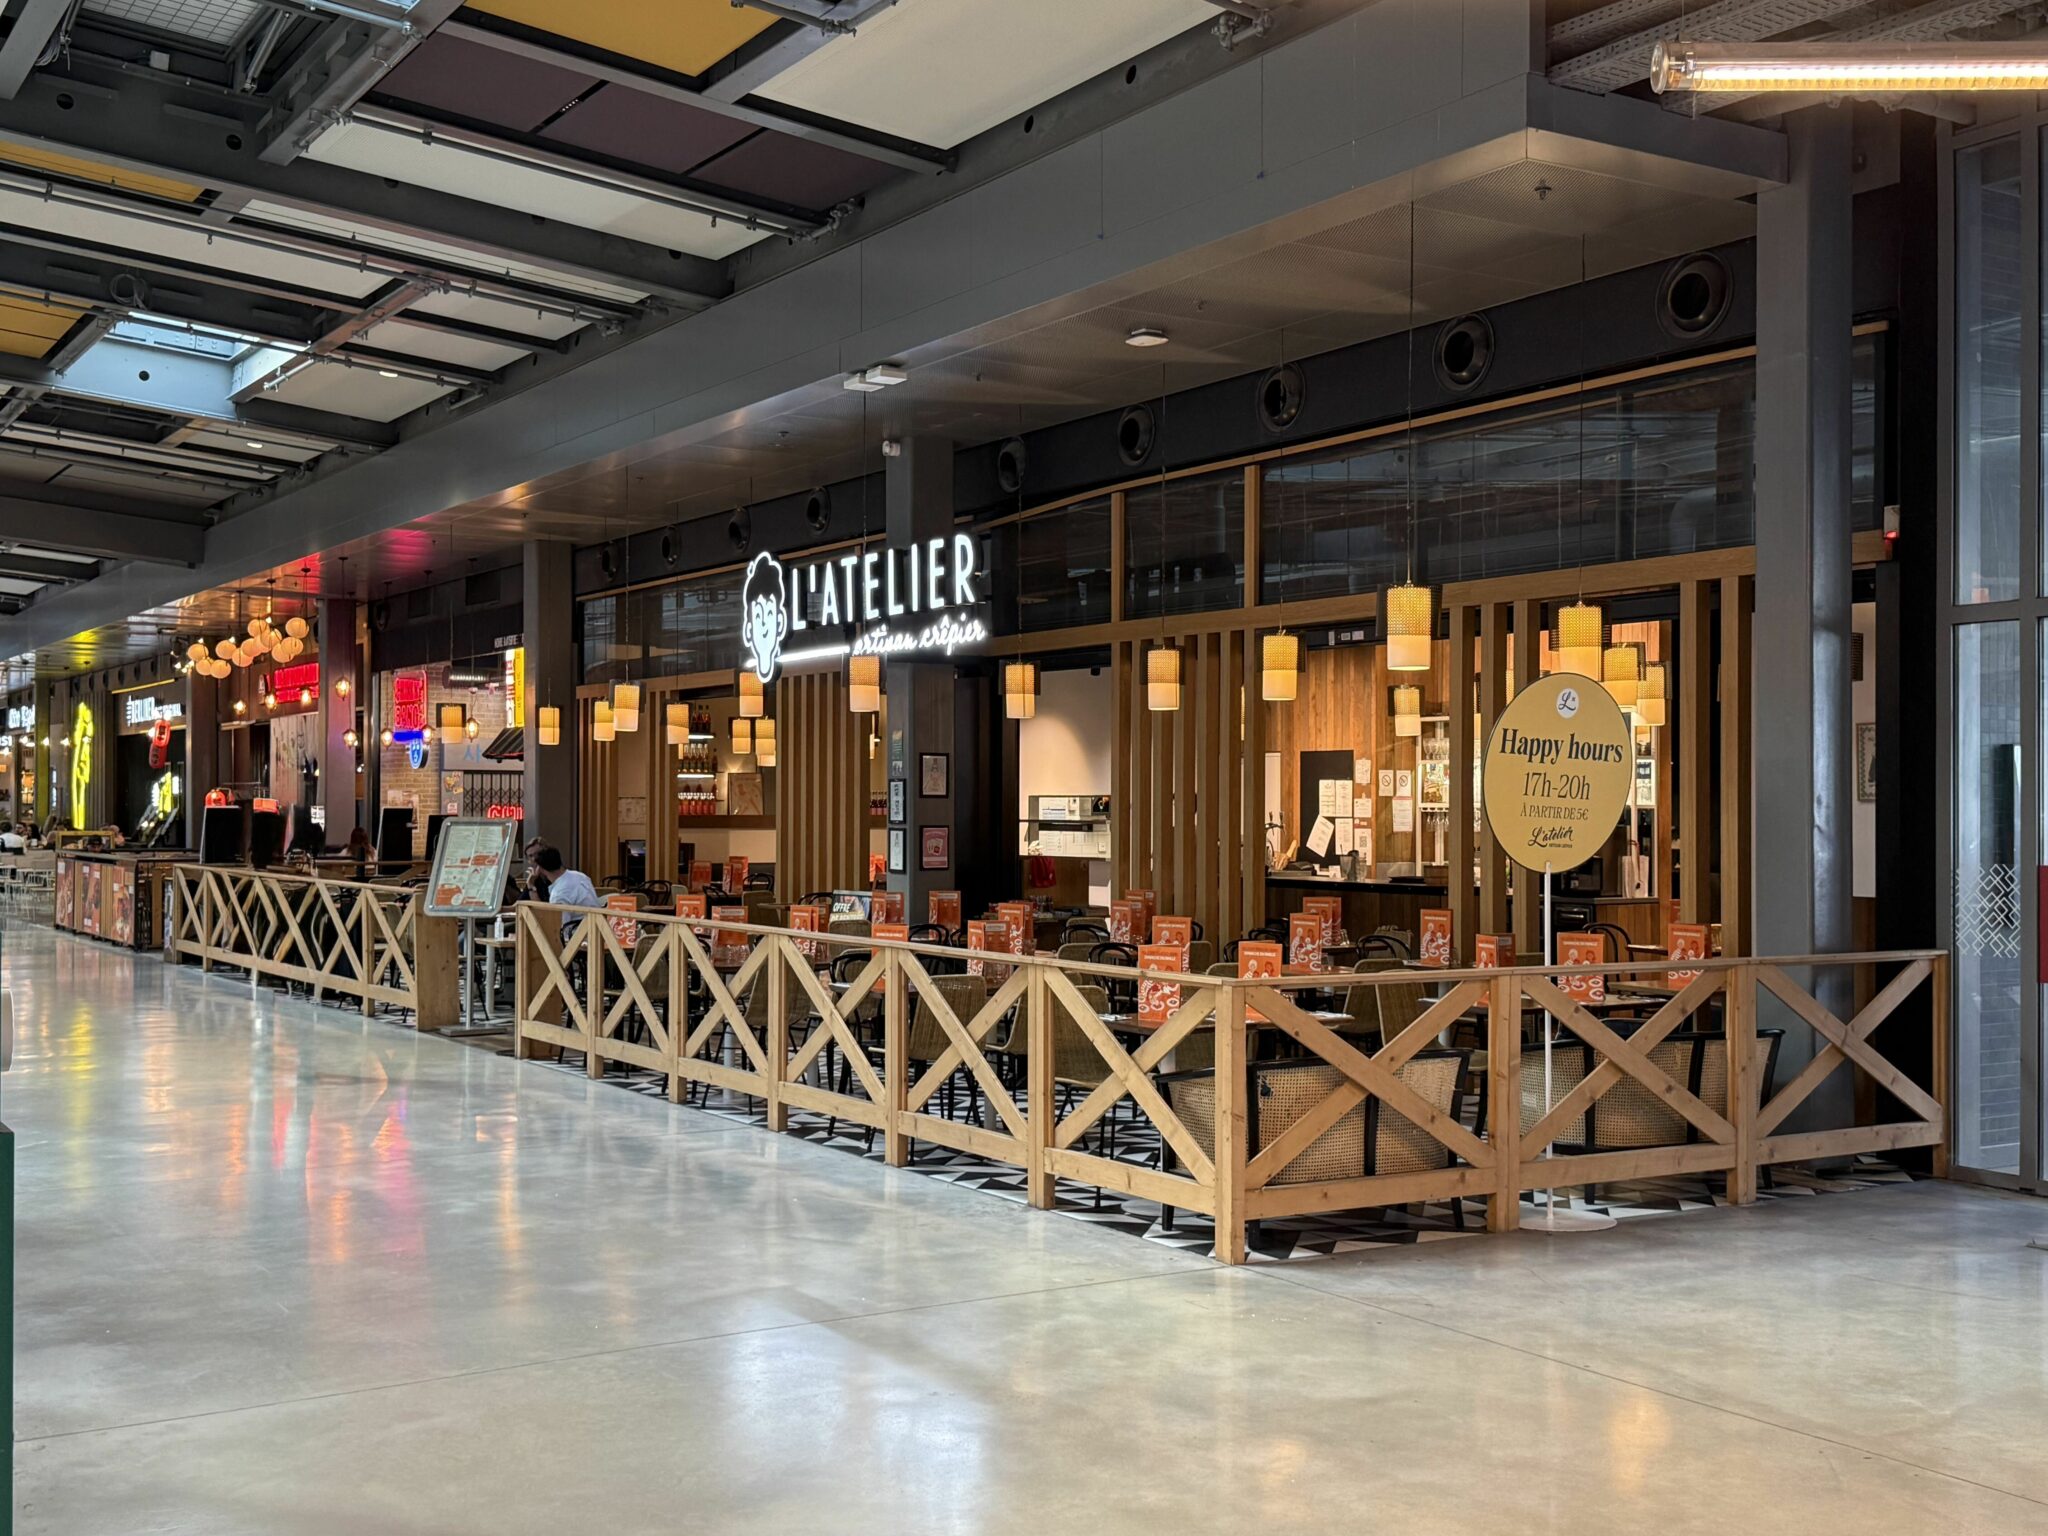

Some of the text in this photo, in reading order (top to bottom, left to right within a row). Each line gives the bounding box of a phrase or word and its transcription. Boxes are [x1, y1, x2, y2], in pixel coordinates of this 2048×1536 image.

[792, 533, 976, 631] L'ATELIER
[853, 623, 917, 656] artisan
[1499, 727, 1624, 765] Happy hours
[1522, 771, 1590, 800] 17h-20h
[1528, 805, 1562, 819] PARTIR
[1528, 825, 1574, 849] L'atelier
